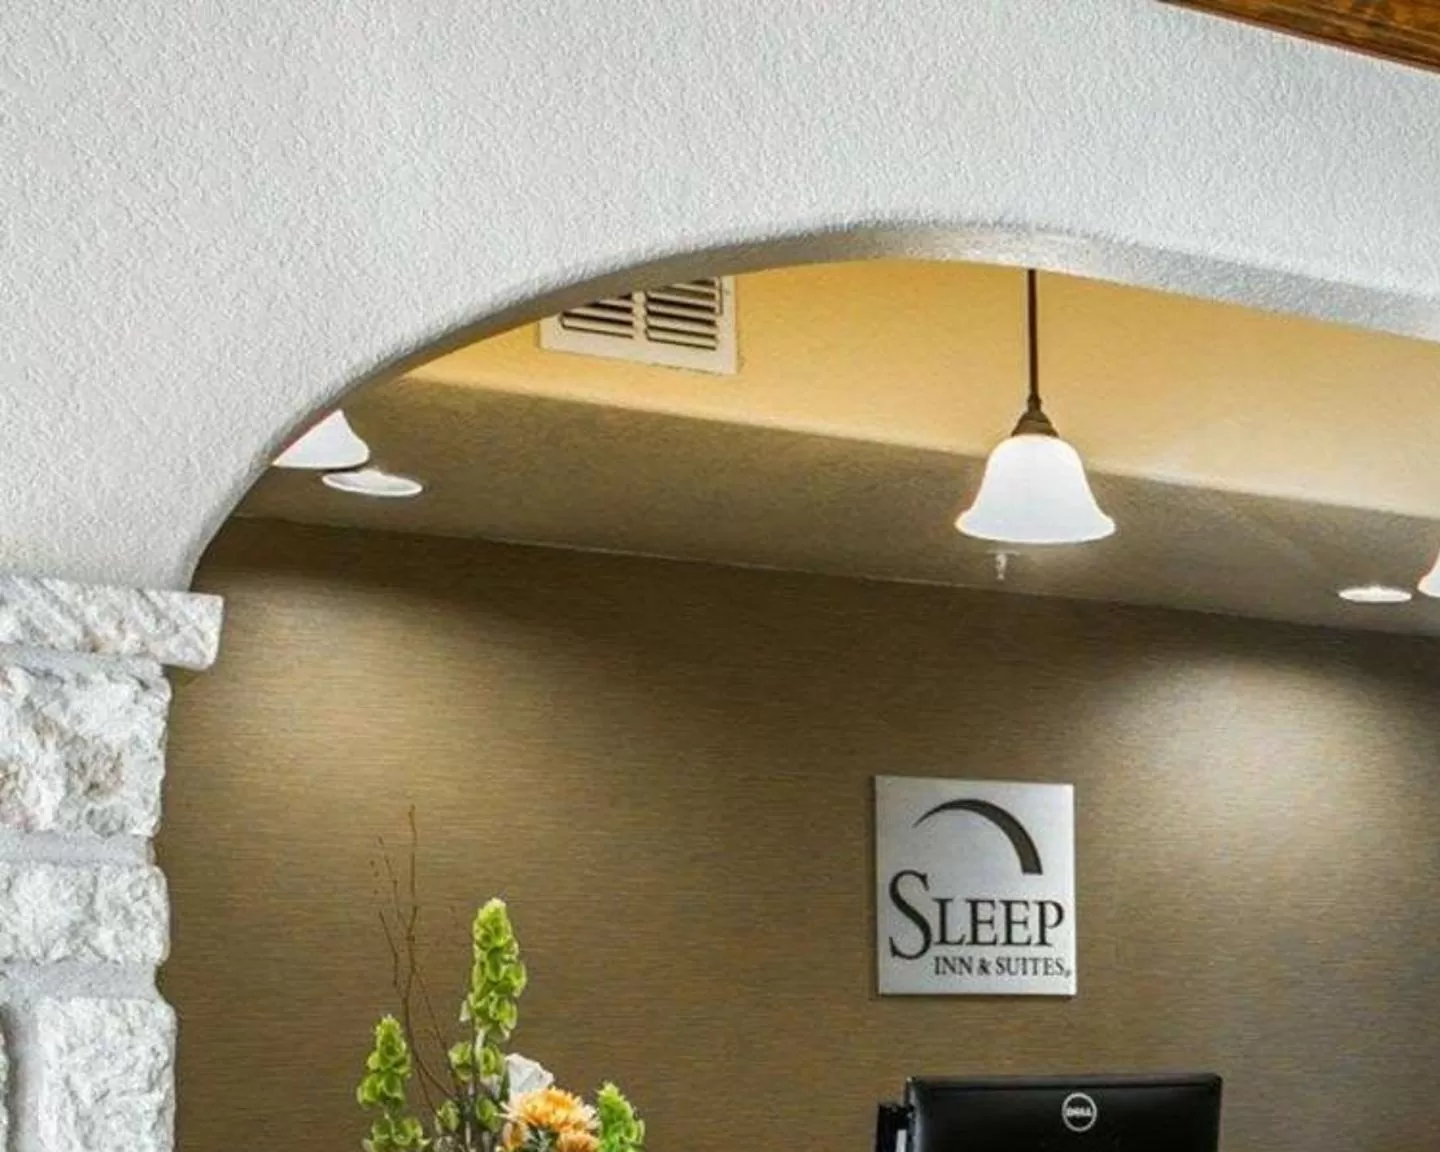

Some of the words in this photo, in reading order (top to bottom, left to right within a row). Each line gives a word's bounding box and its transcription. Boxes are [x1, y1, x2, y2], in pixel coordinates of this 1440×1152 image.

[889, 870, 1064, 960] SLEEP
[934, 956, 973, 976] INN
[978, 957, 991, 976] &
[1066, 1106, 1092, 1117] DELL
